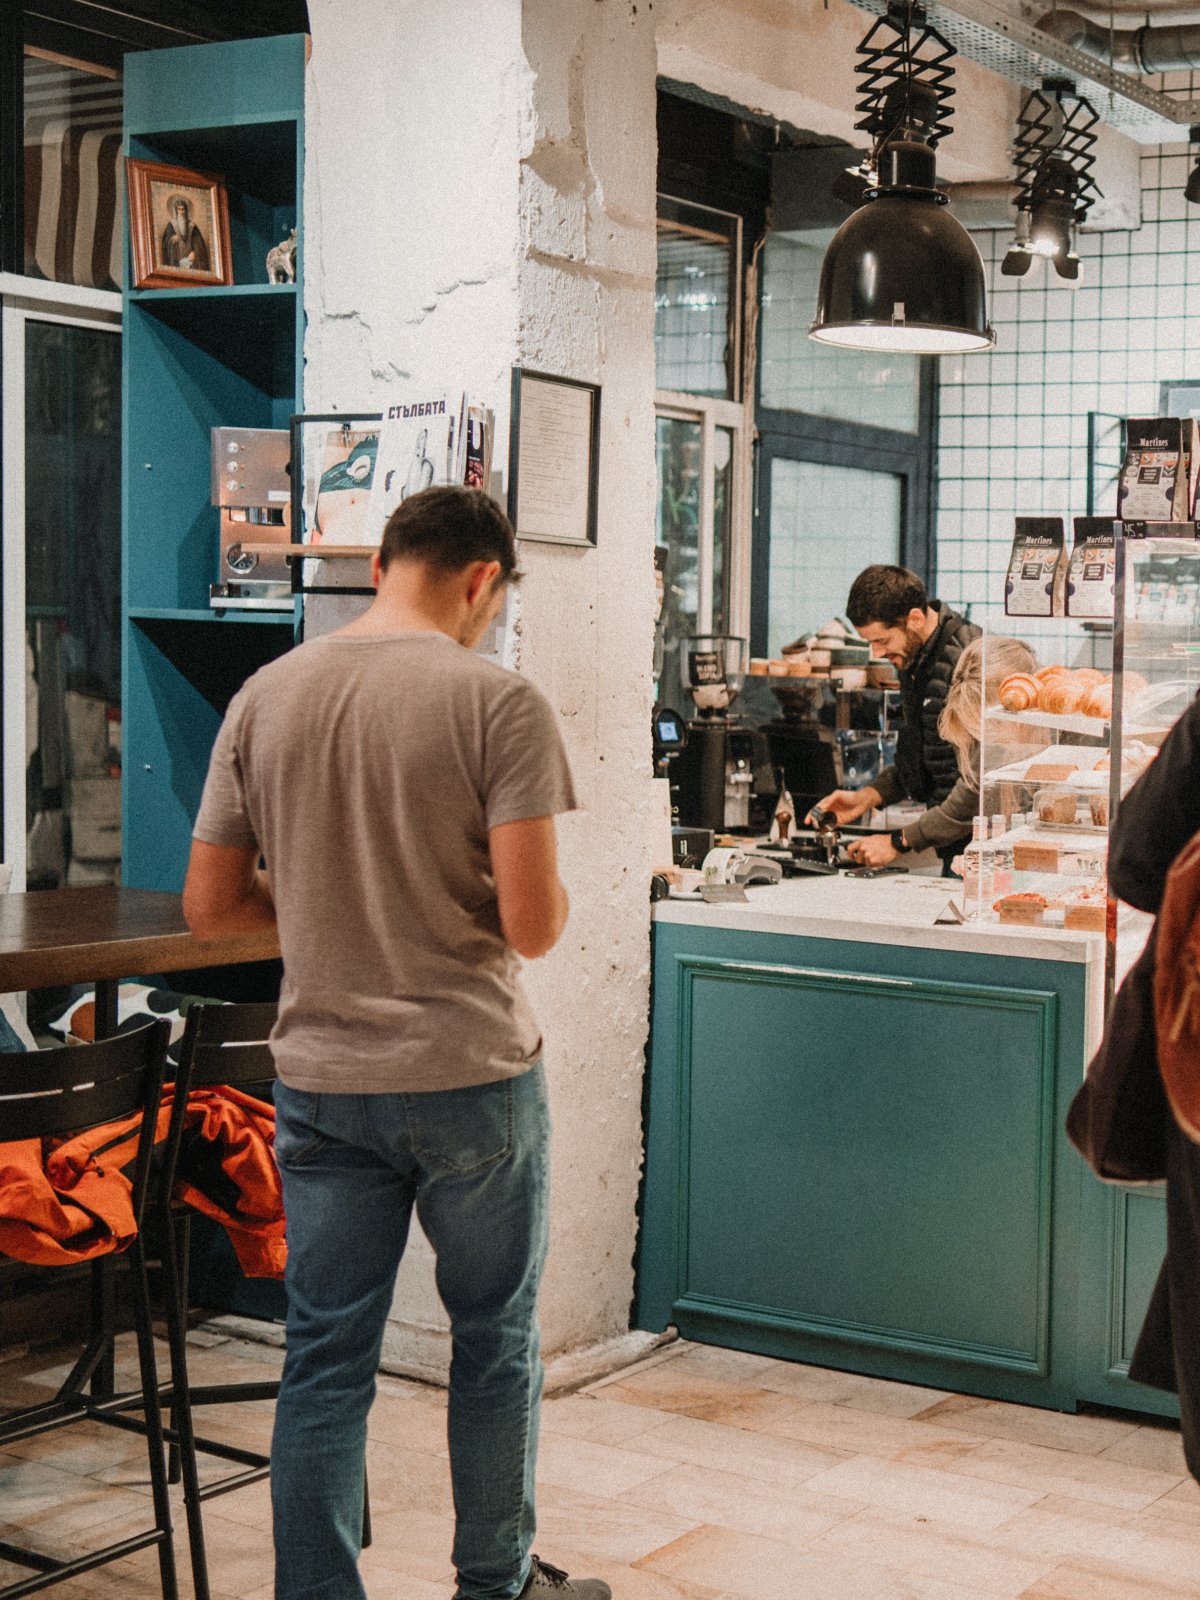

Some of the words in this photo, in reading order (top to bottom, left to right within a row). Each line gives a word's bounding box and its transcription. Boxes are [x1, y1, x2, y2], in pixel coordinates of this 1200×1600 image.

[388, 400, 446, 420] СТЪЛБАТА
[1140, 437, 1169, 448] Martines
[1026, 535, 1053, 545] Martines
[1086, 535, 1113, 544] Martines
